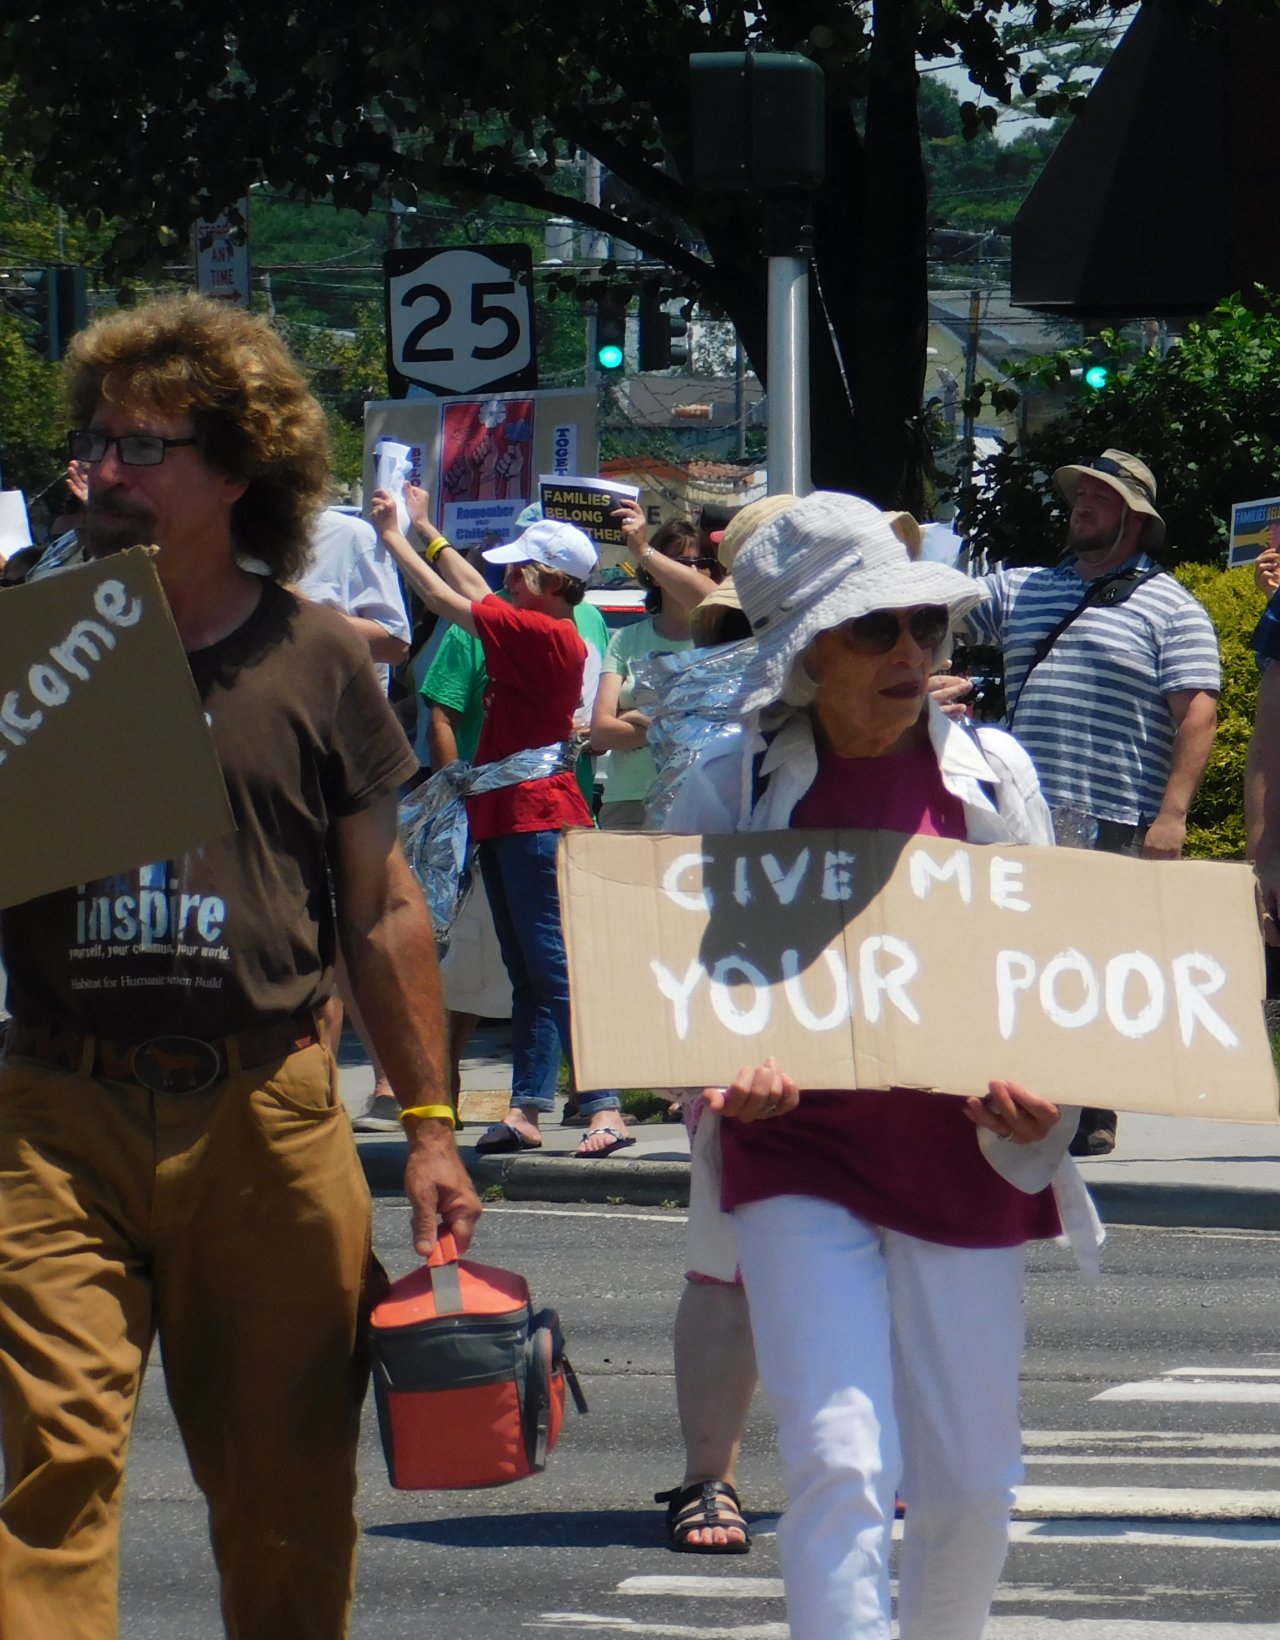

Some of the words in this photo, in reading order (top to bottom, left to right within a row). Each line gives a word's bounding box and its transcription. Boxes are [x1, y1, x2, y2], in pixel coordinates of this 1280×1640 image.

[211, 246, 234, 261] ANY
[210, 268, 235, 284] TIME
[401, 283, 521, 363] 25
[543, 490, 611, 506] FAMILIES
[456, 505, 515, 520] Remember
[545, 507, 603, 523] BELONG
[1237, 508, 1266, 524] FAMILIES
[662, 847, 855, 912] GIVE
[910, 850, 1032, 912] ME
[77, 879, 225, 950] inspire
[103, 976, 118, 988] for
[650, 935, 920, 1040] YOUR
[996, 946, 1240, 1049] POOR
